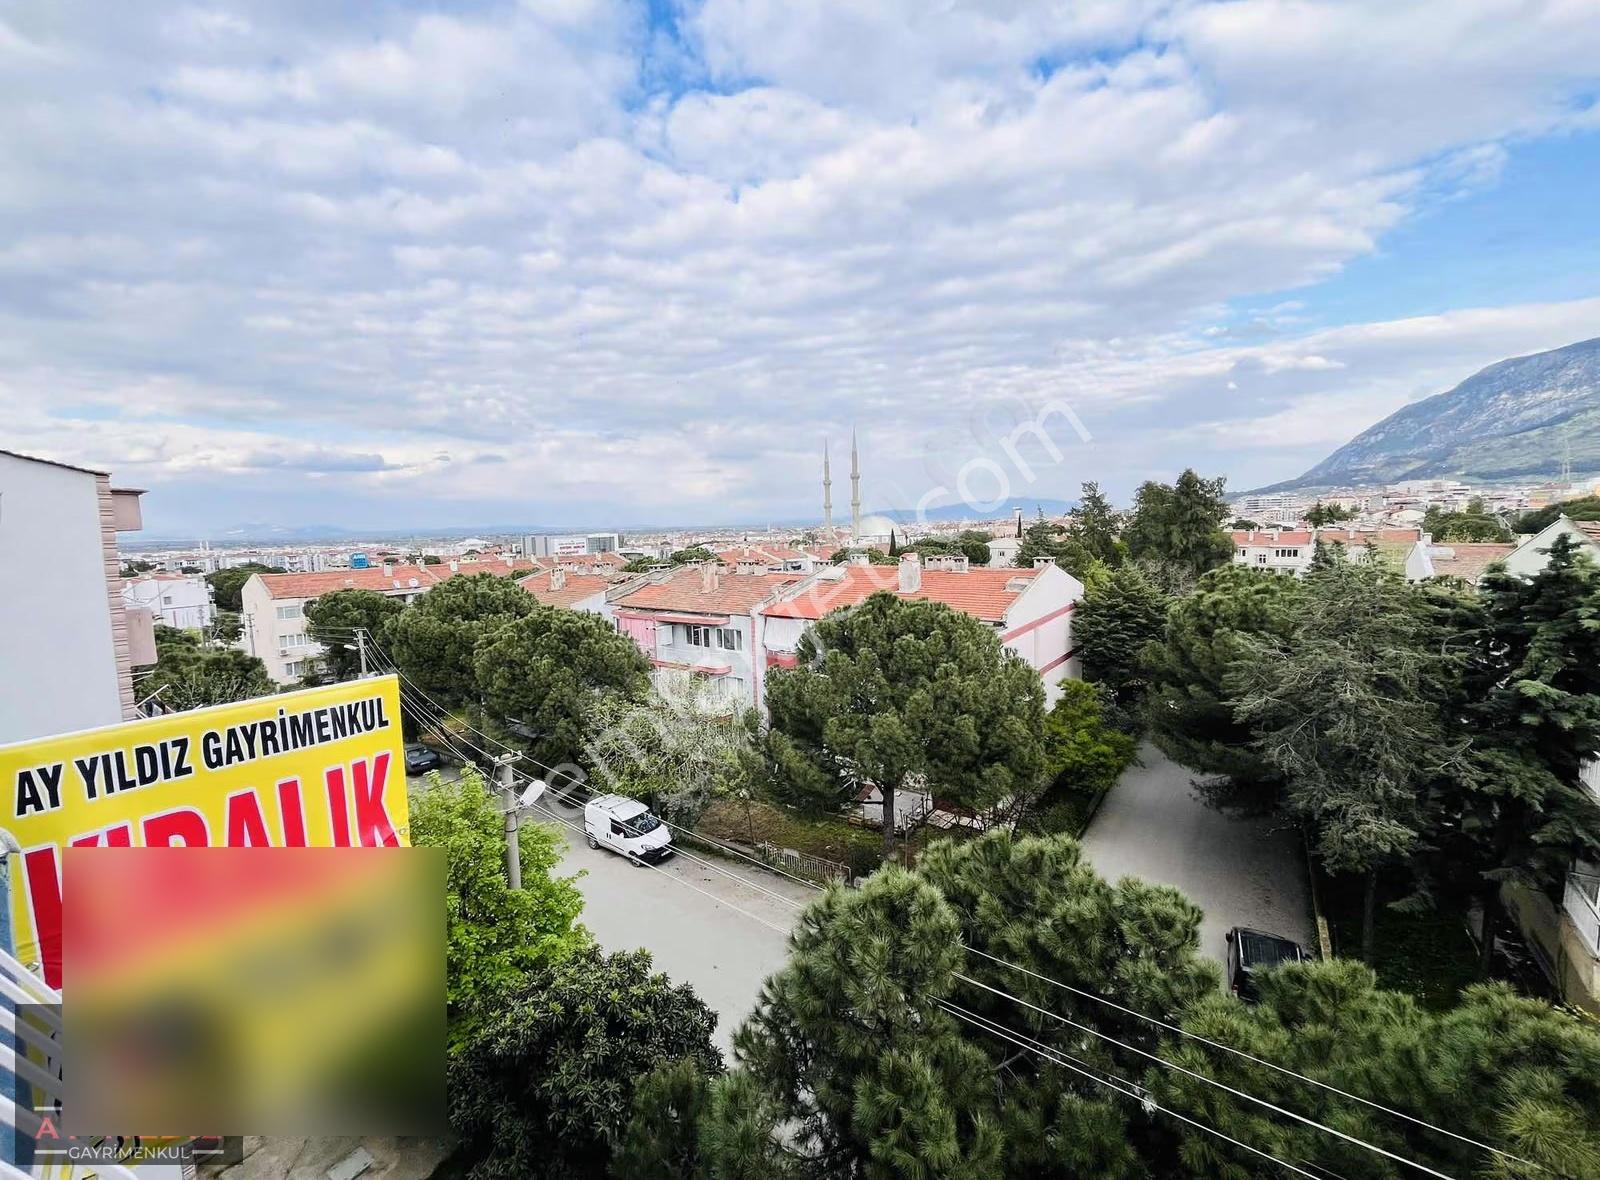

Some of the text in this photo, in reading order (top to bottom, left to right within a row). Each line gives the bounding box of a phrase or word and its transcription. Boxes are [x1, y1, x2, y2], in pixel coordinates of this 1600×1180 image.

[16, 697, 389, 816] AY YILDIZ GAYRİMENKUL
